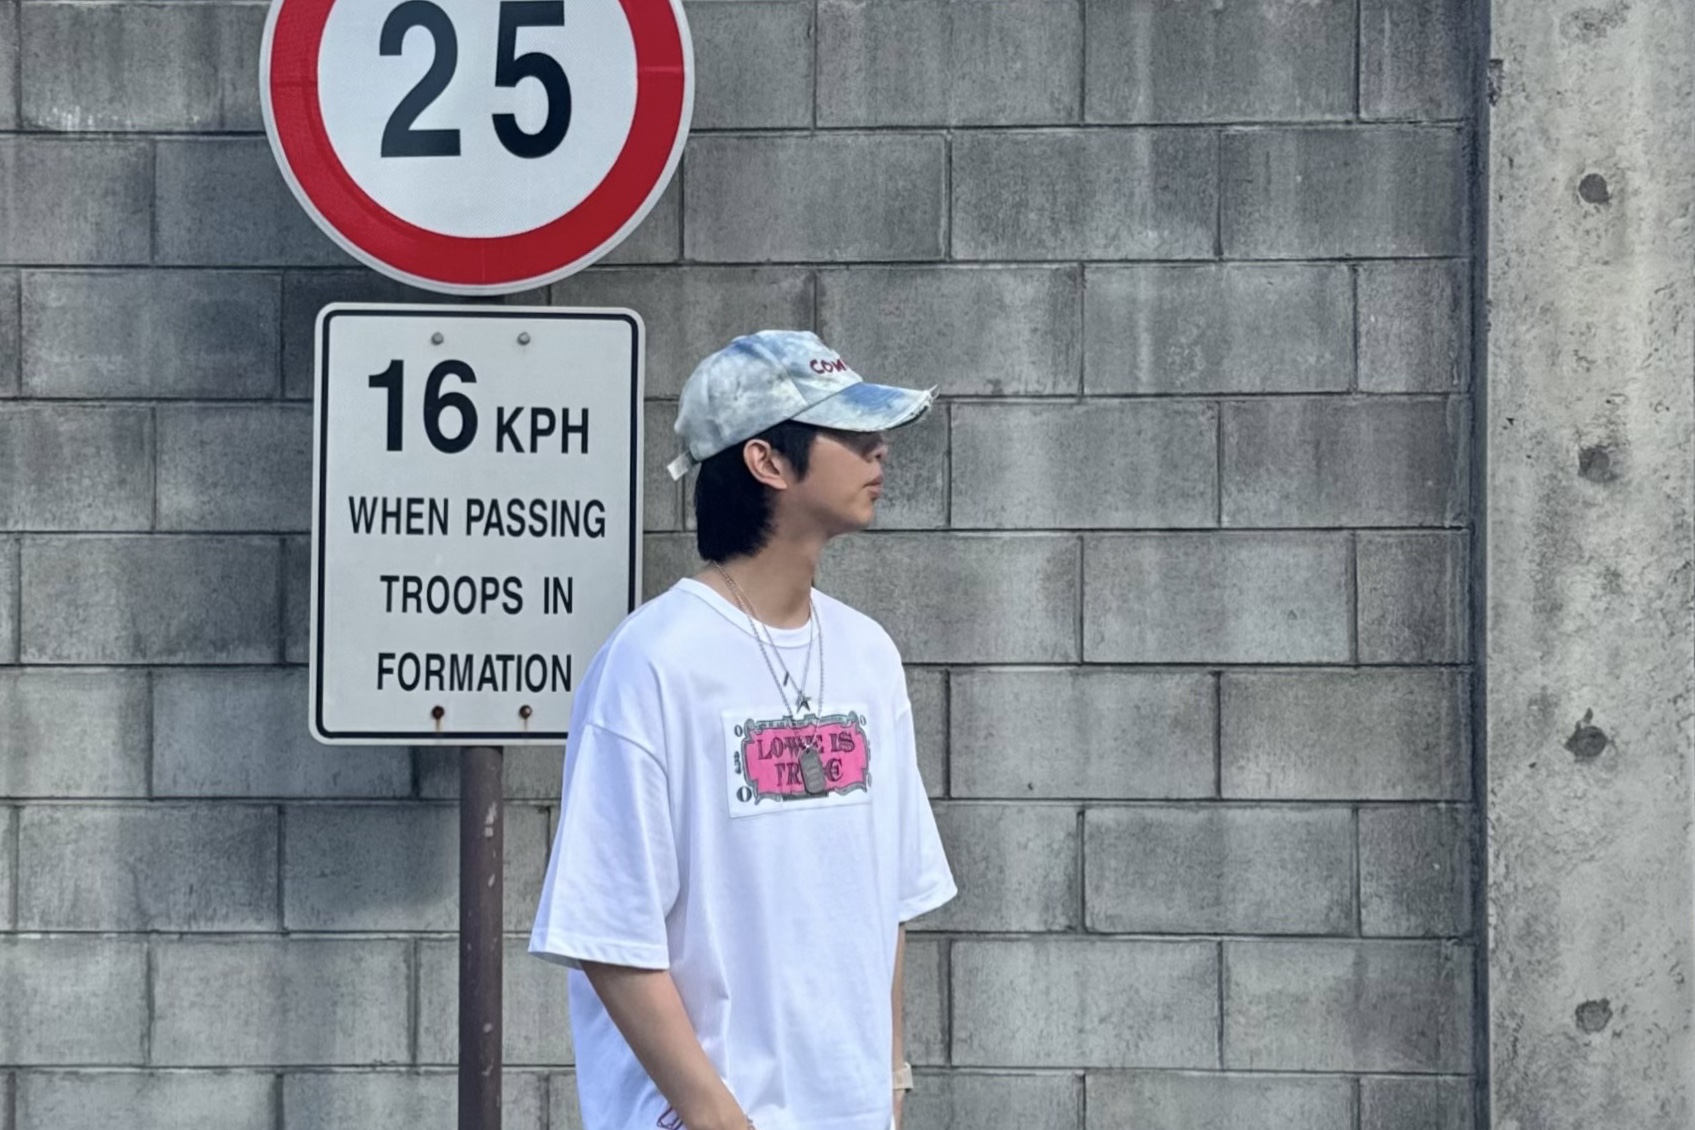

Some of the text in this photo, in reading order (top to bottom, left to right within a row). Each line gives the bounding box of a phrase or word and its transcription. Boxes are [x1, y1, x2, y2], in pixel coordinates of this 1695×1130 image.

[380, 0, 571, 158] 25
[369, 360, 588, 453] 16 KPH
[349, 496, 605, 538] WHEN PASSING
[380, 575, 572, 614] TROOPS IN
[378, 652, 571, 692] FORMATION
[829, 731, 856, 753] IS
[774, 758, 843, 787] TRE
